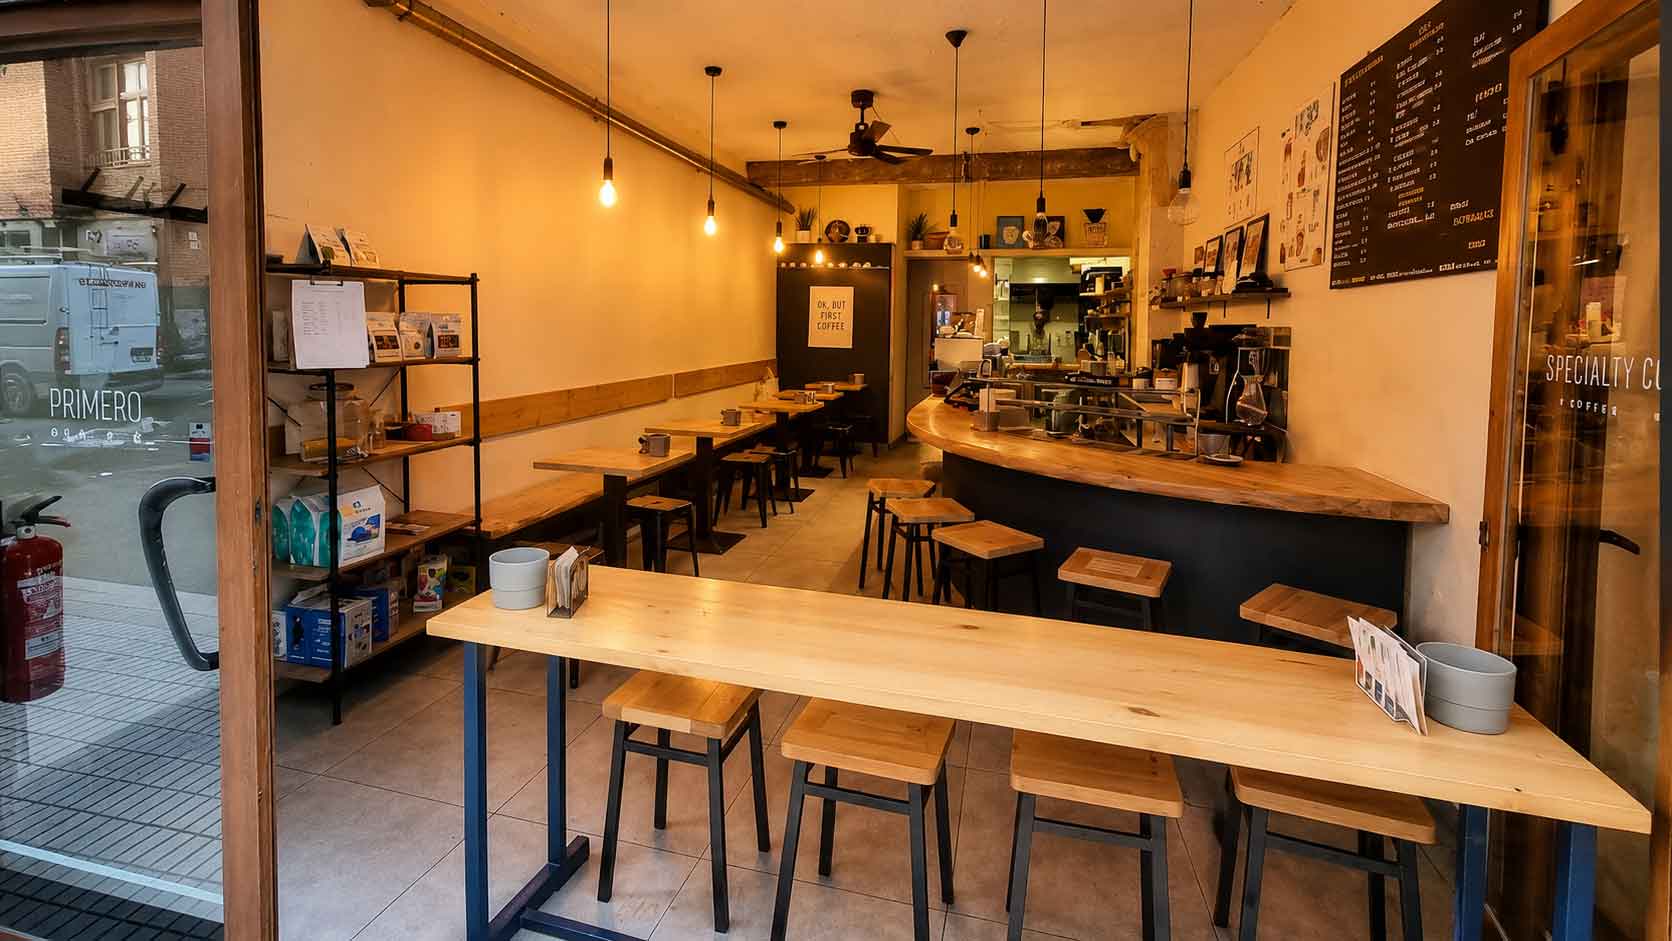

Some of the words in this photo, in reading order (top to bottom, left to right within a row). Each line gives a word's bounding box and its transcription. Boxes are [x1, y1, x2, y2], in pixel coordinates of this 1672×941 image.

[817, 322, 845, 330] COFFEE
[820, 311, 841, 320] FIRST
[1546, 355, 1634, 388] SPECIALTY
[49, 387, 142, 422] PRIMERO
